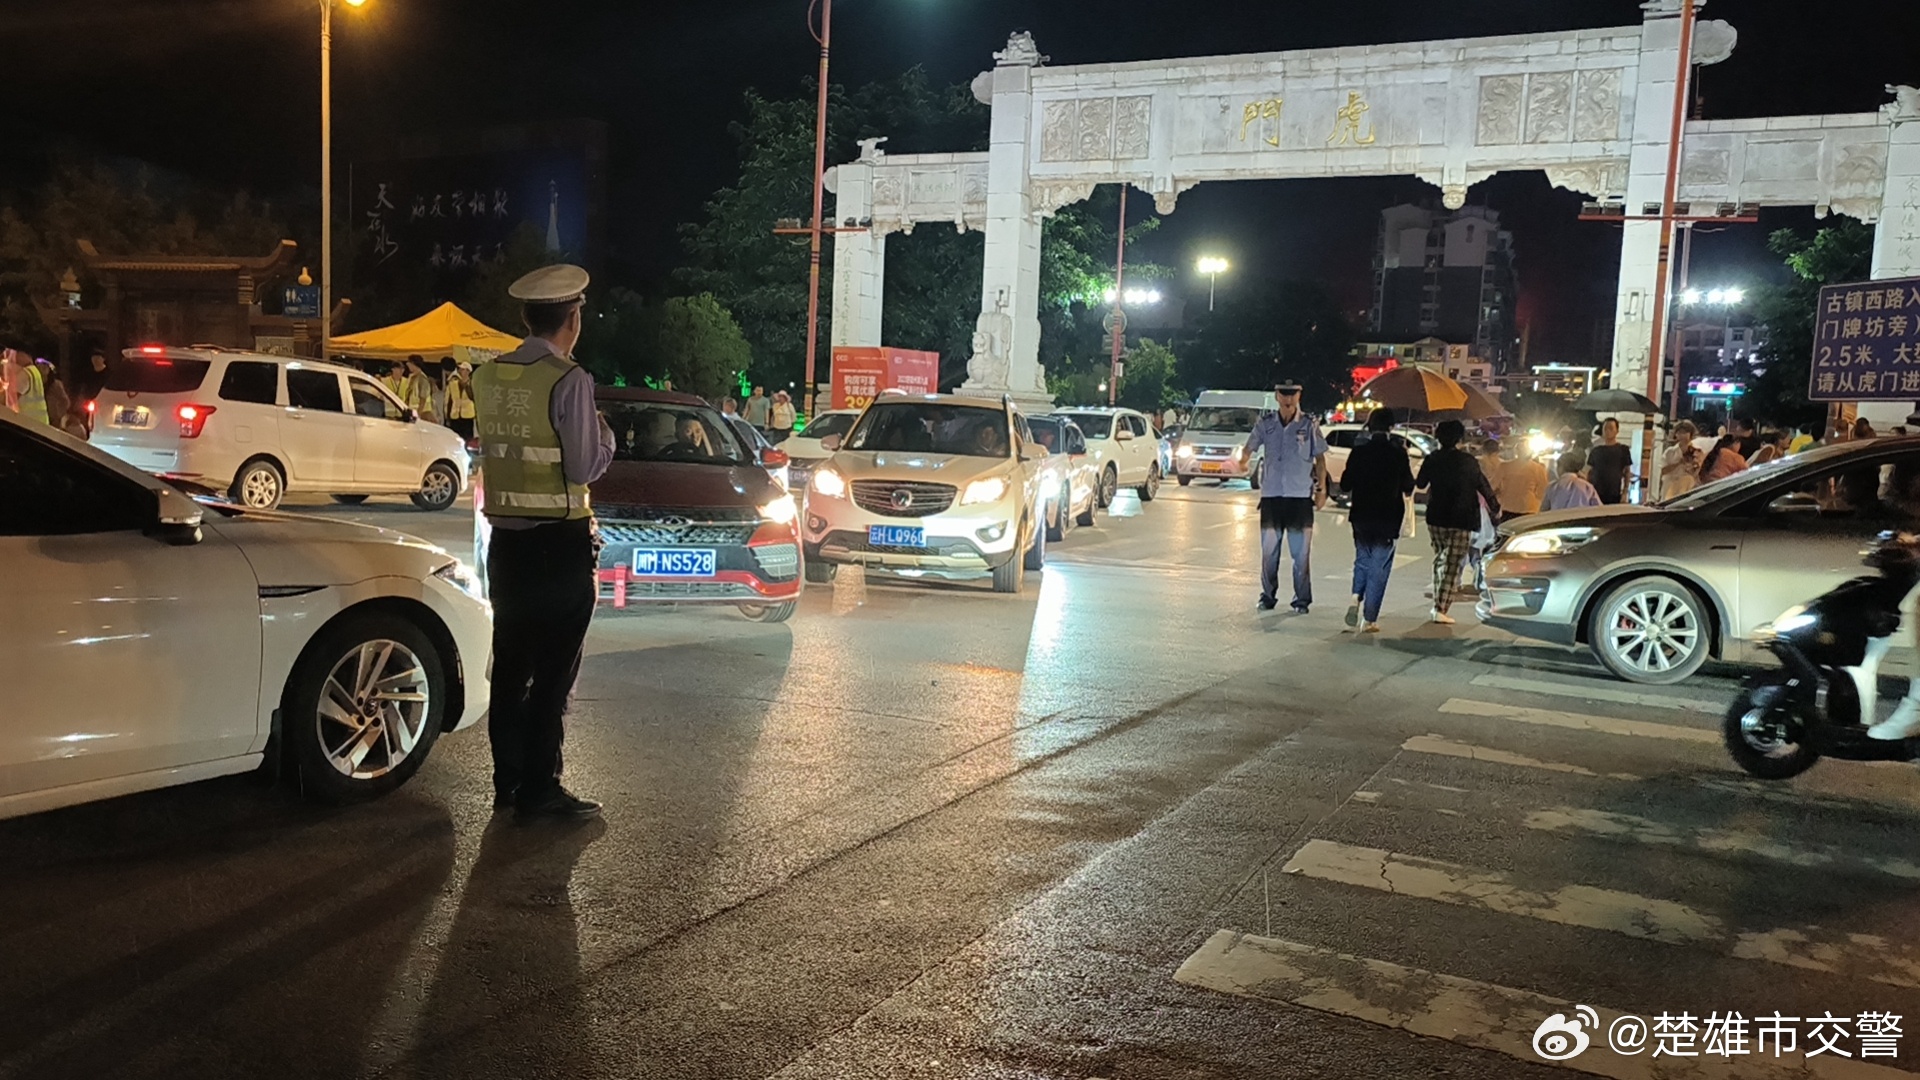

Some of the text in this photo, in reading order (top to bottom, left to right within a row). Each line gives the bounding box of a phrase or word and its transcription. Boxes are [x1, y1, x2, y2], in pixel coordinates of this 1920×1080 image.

[1816, 370, 1920, 393] 请从虎门进
[482, 384, 532, 418] 警察
[481, 421, 532, 439] OLICE
